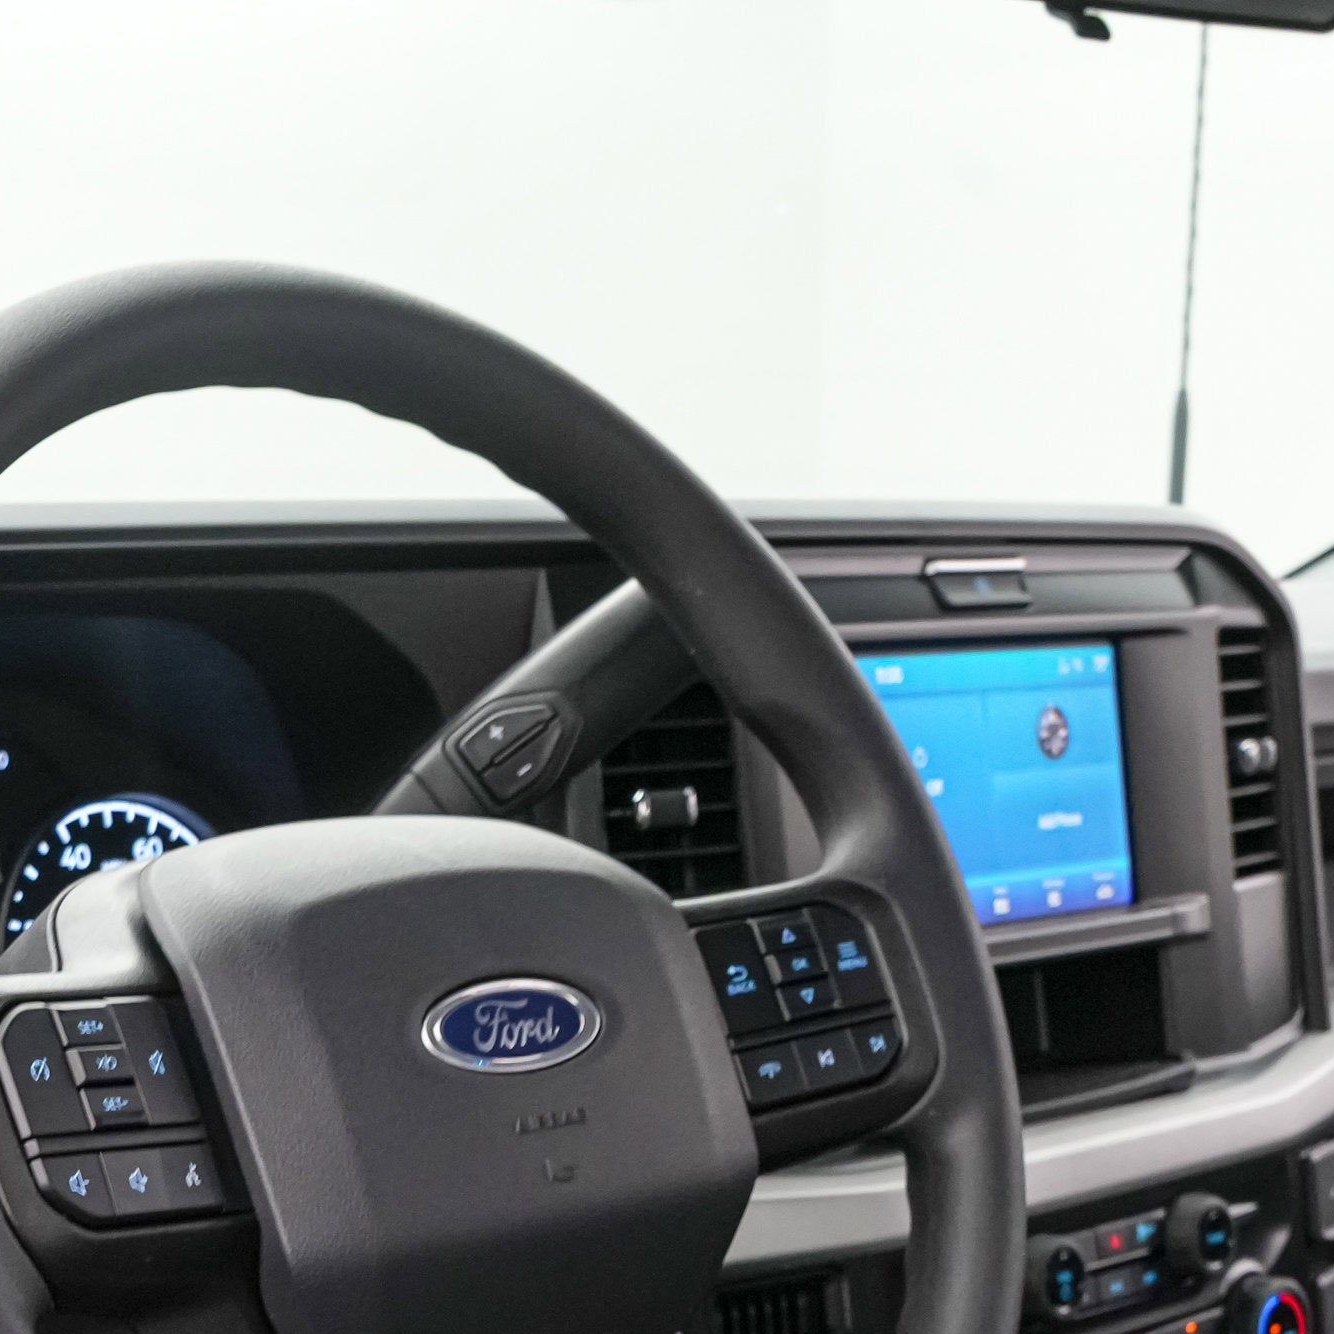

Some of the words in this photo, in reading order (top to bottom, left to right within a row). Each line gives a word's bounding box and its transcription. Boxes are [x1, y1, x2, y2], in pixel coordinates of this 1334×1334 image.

[59, 842, 92, 872] 40
[132, 836, 164, 864] 60
[473, 998, 560, 1053] Ford
